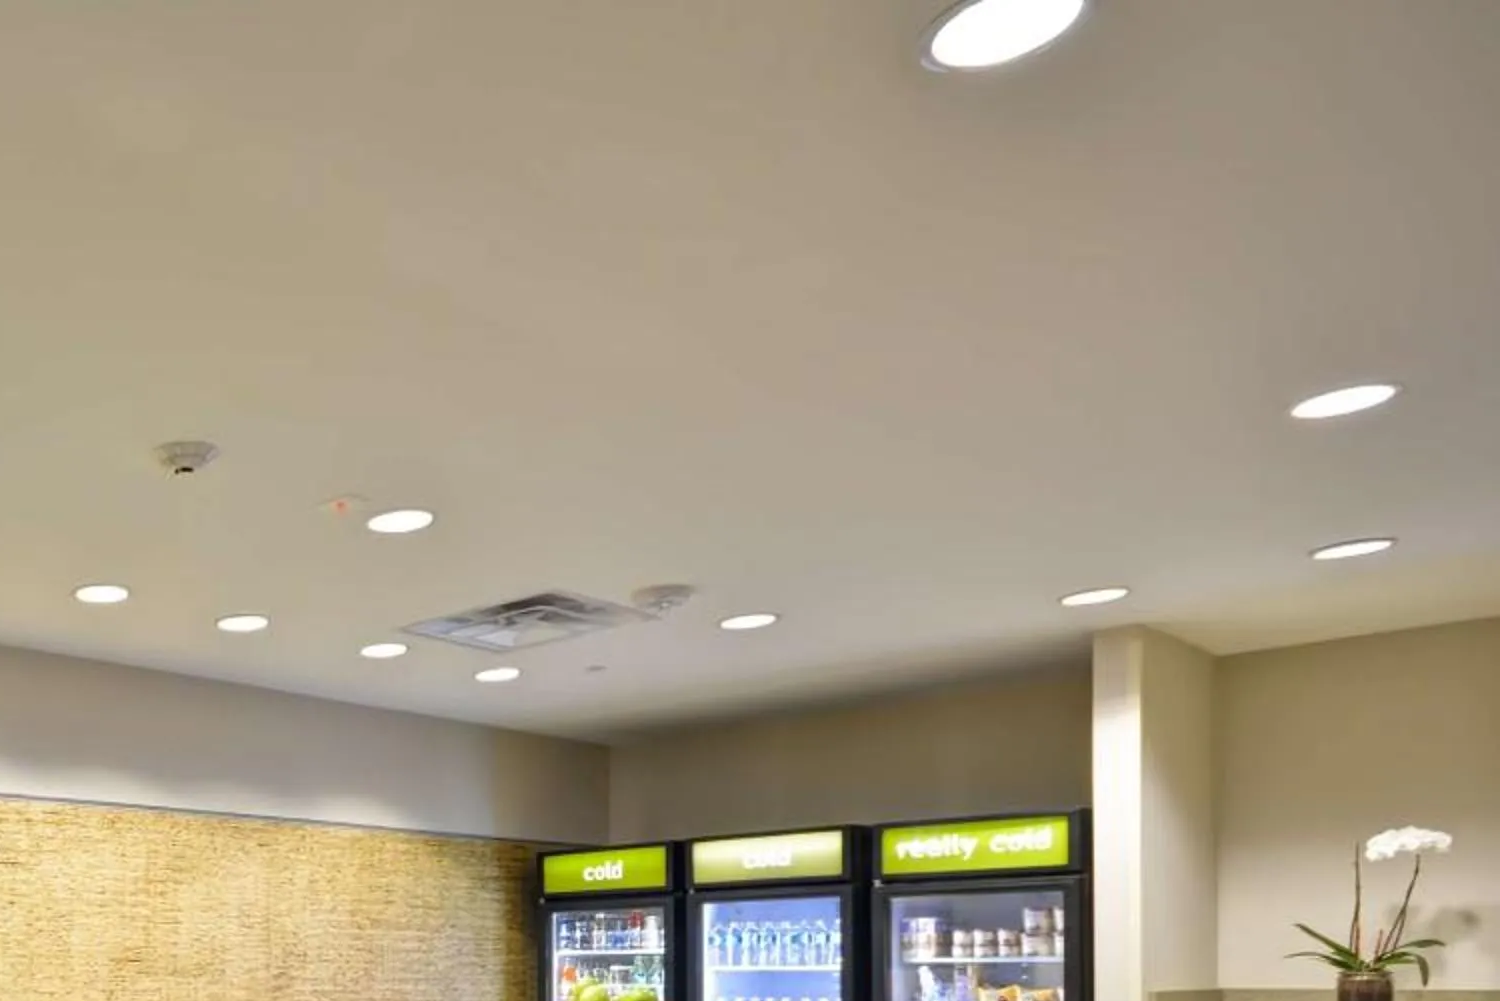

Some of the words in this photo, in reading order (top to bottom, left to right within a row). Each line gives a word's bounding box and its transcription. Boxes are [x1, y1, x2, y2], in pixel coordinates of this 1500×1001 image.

[895, 833, 979, 861] really
[988, 825, 1053, 854] cold
[582, 860, 624, 881] cold
